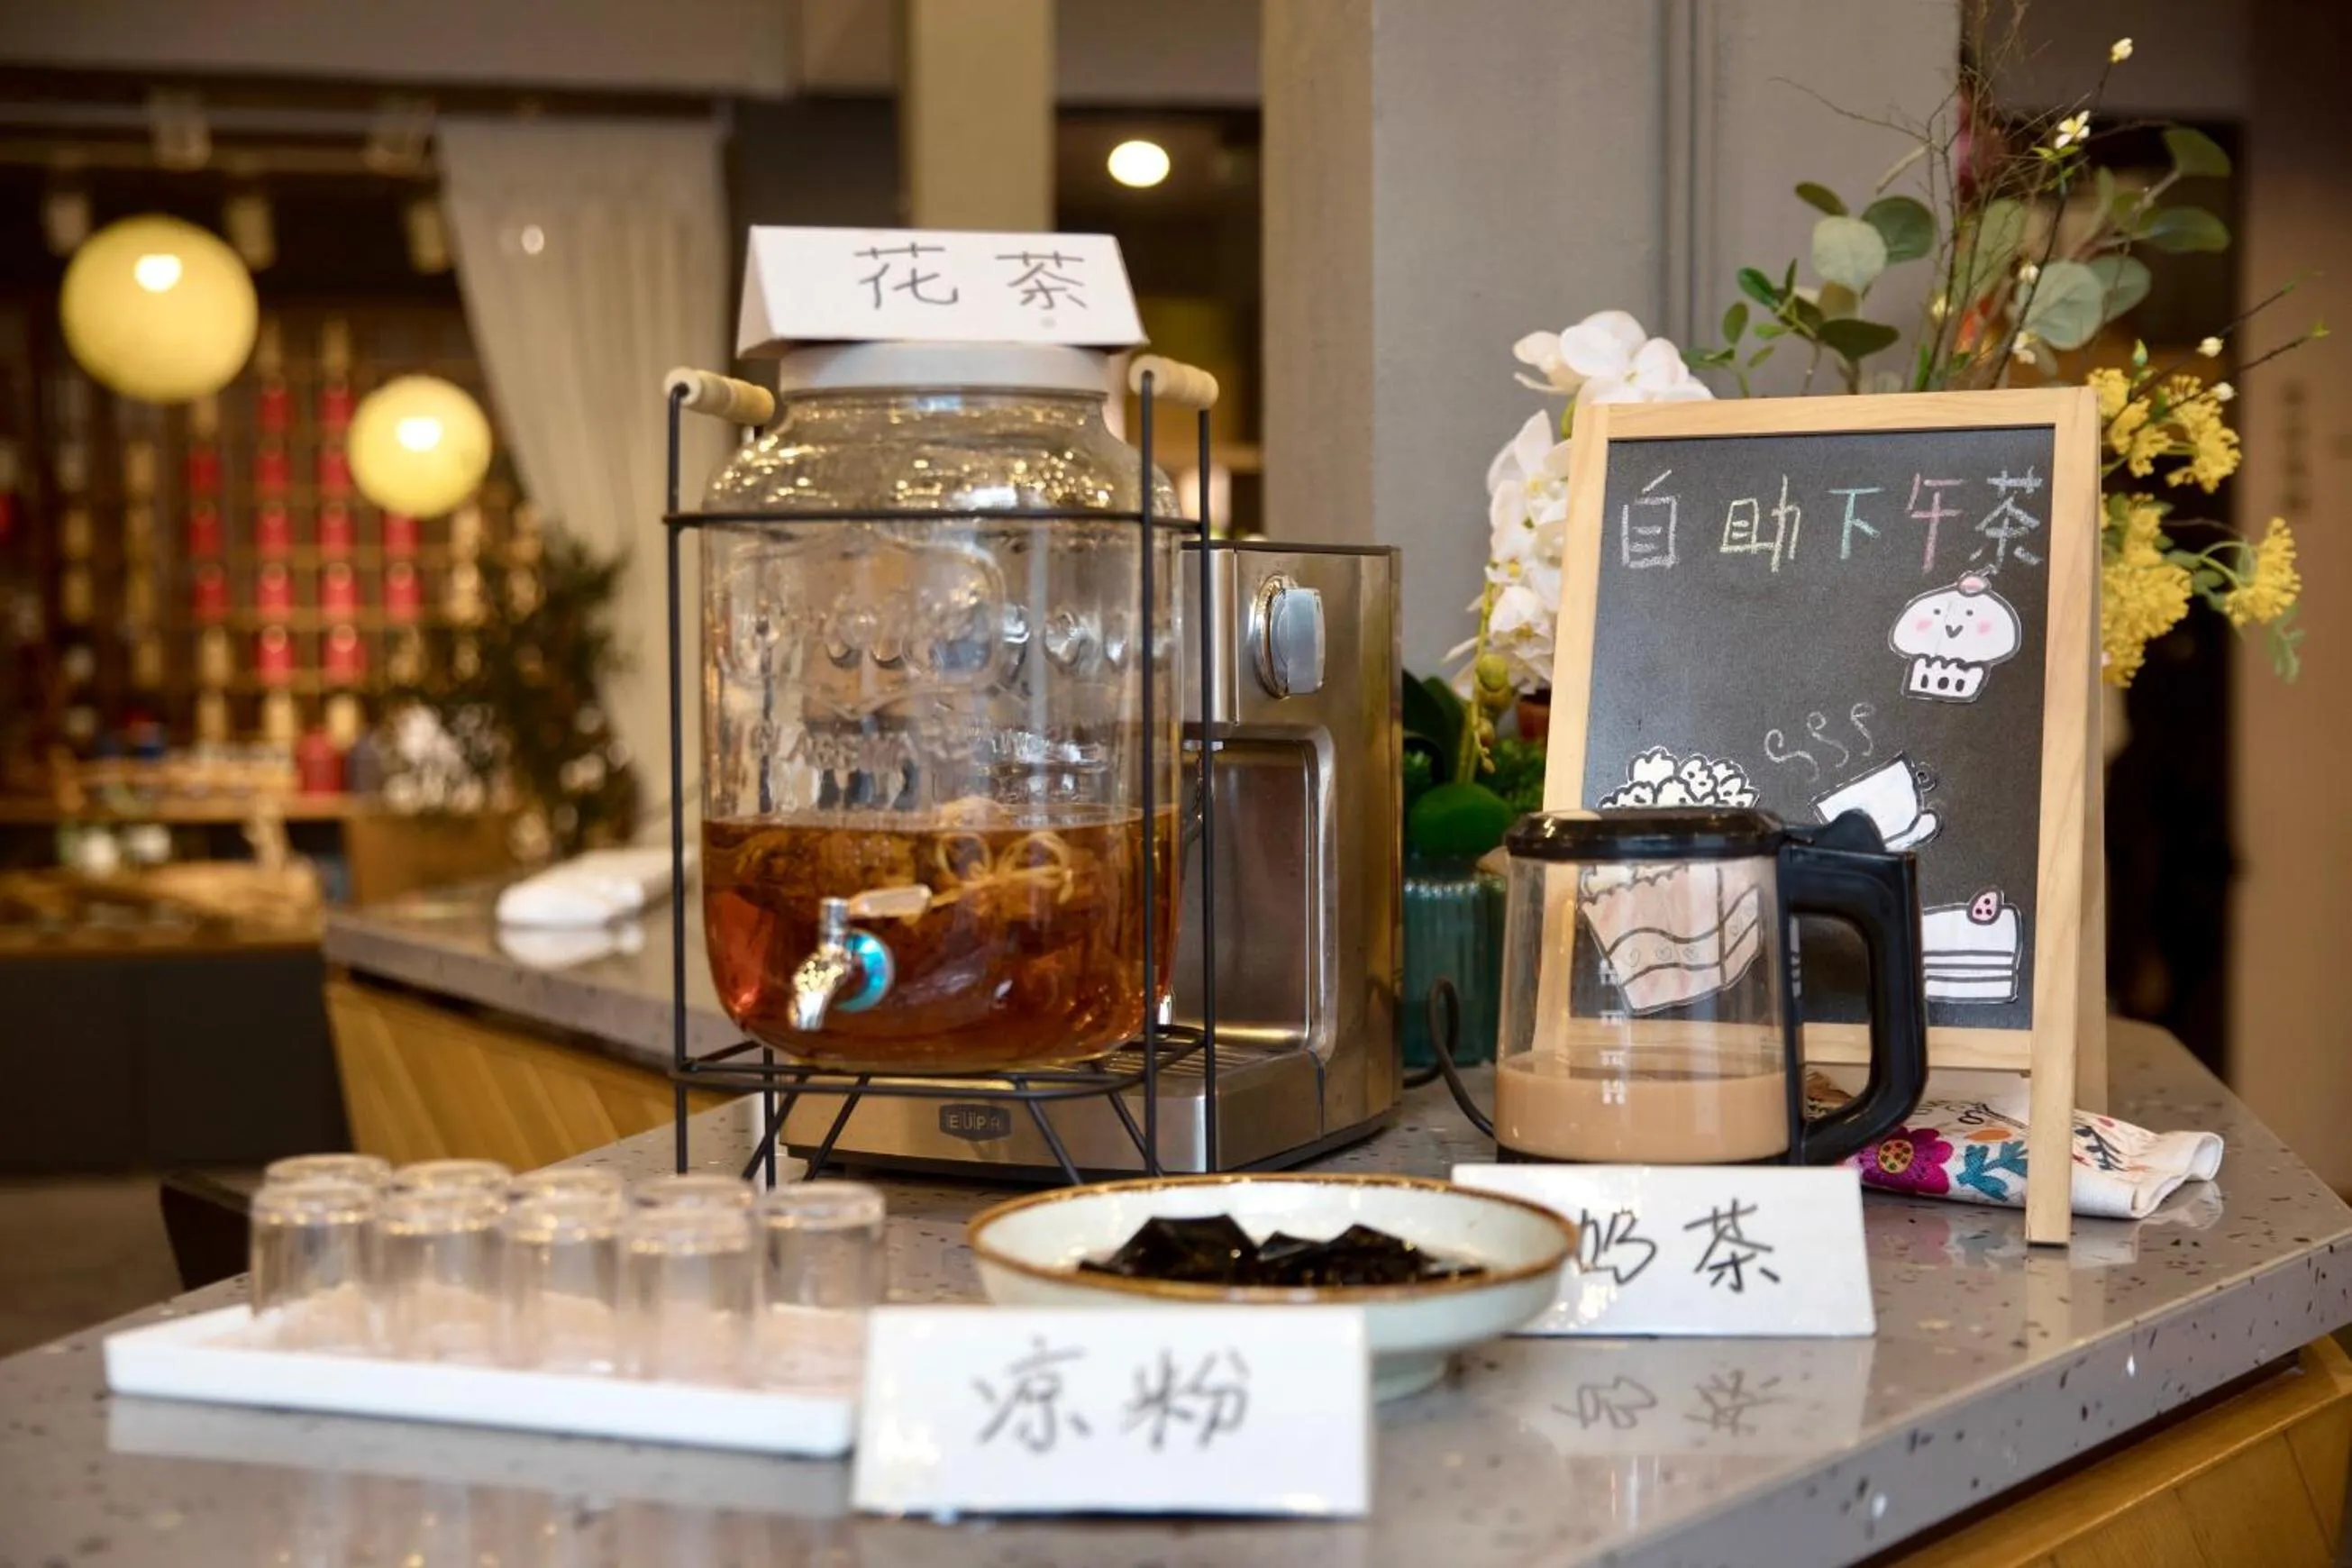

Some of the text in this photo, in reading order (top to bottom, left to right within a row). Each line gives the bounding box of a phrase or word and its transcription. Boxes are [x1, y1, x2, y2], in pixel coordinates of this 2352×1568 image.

[852, 242, 1089, 310] 花茶
[1622, 466, 2044, 574] 自助下午茶
[947, 1112, 1001, 1131] EUPA
[971, 1334, 1253, 1453] 凉粉
